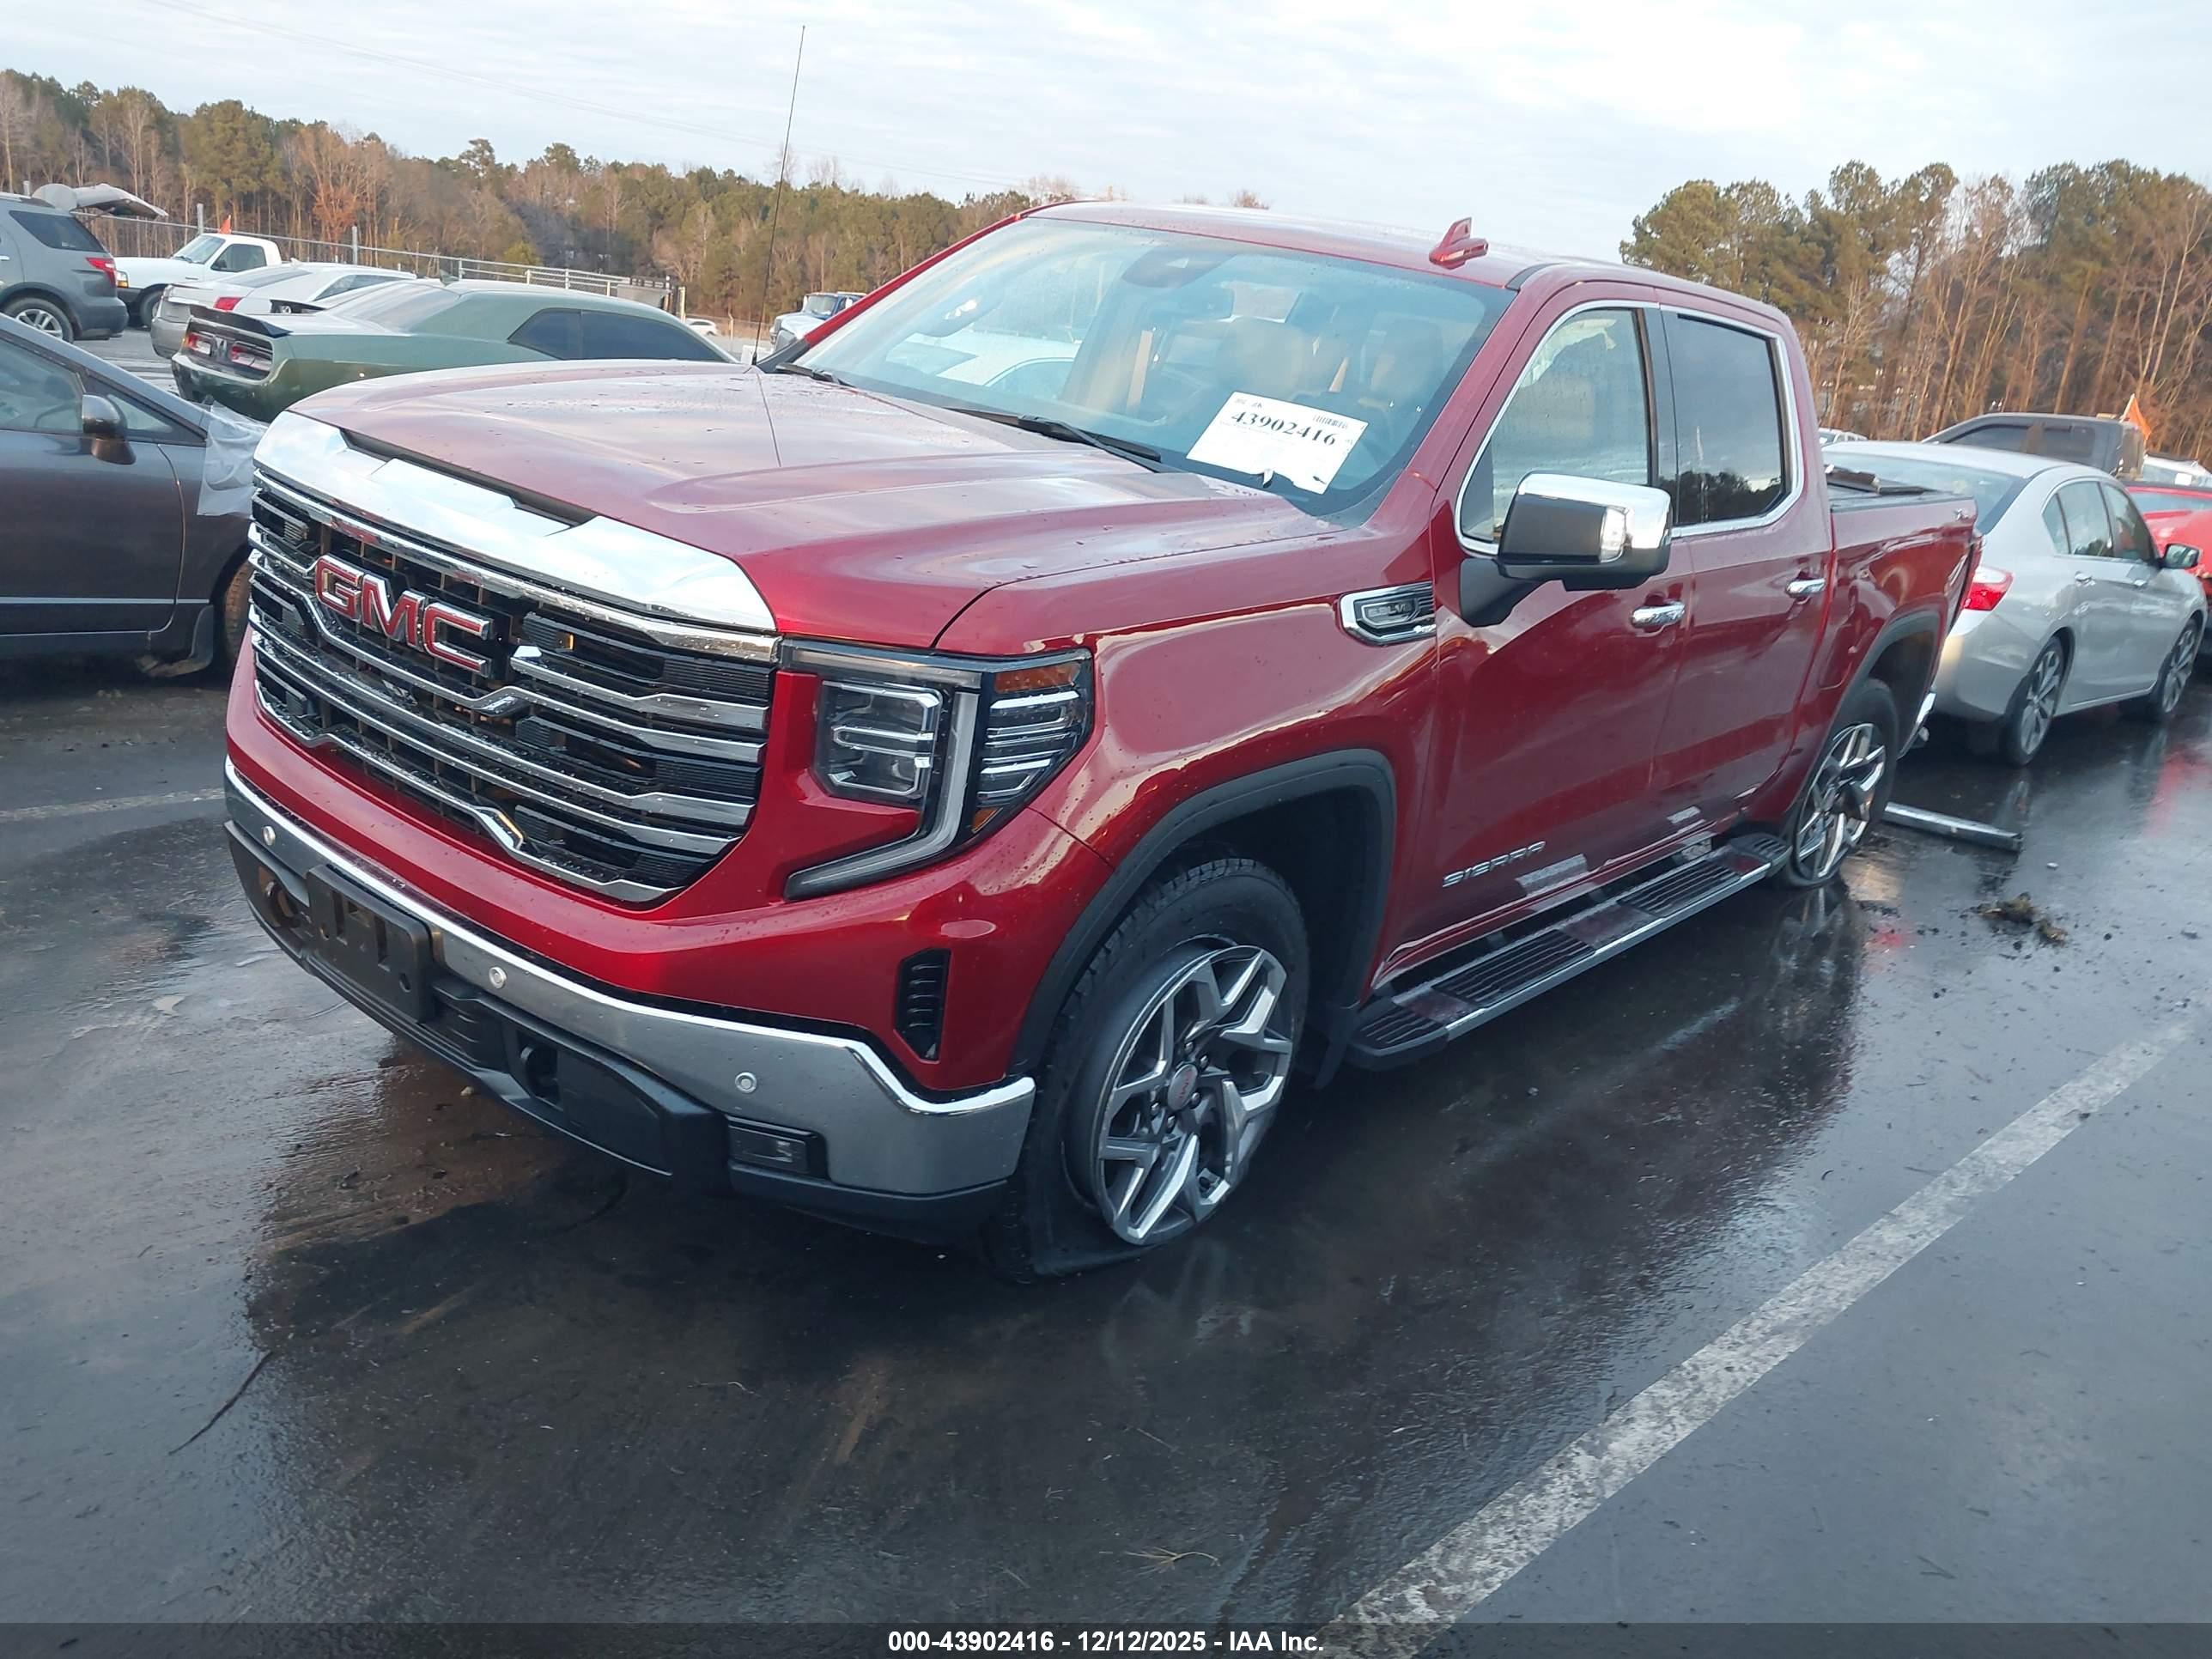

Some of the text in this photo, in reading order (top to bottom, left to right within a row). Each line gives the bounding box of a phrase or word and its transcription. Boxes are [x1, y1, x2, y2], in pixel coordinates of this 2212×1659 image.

[1231, 410, 1339, 447] 43902416
[315, 555, 492, 678] GMC
[1442, 841, 1546, 888] SIERRA
